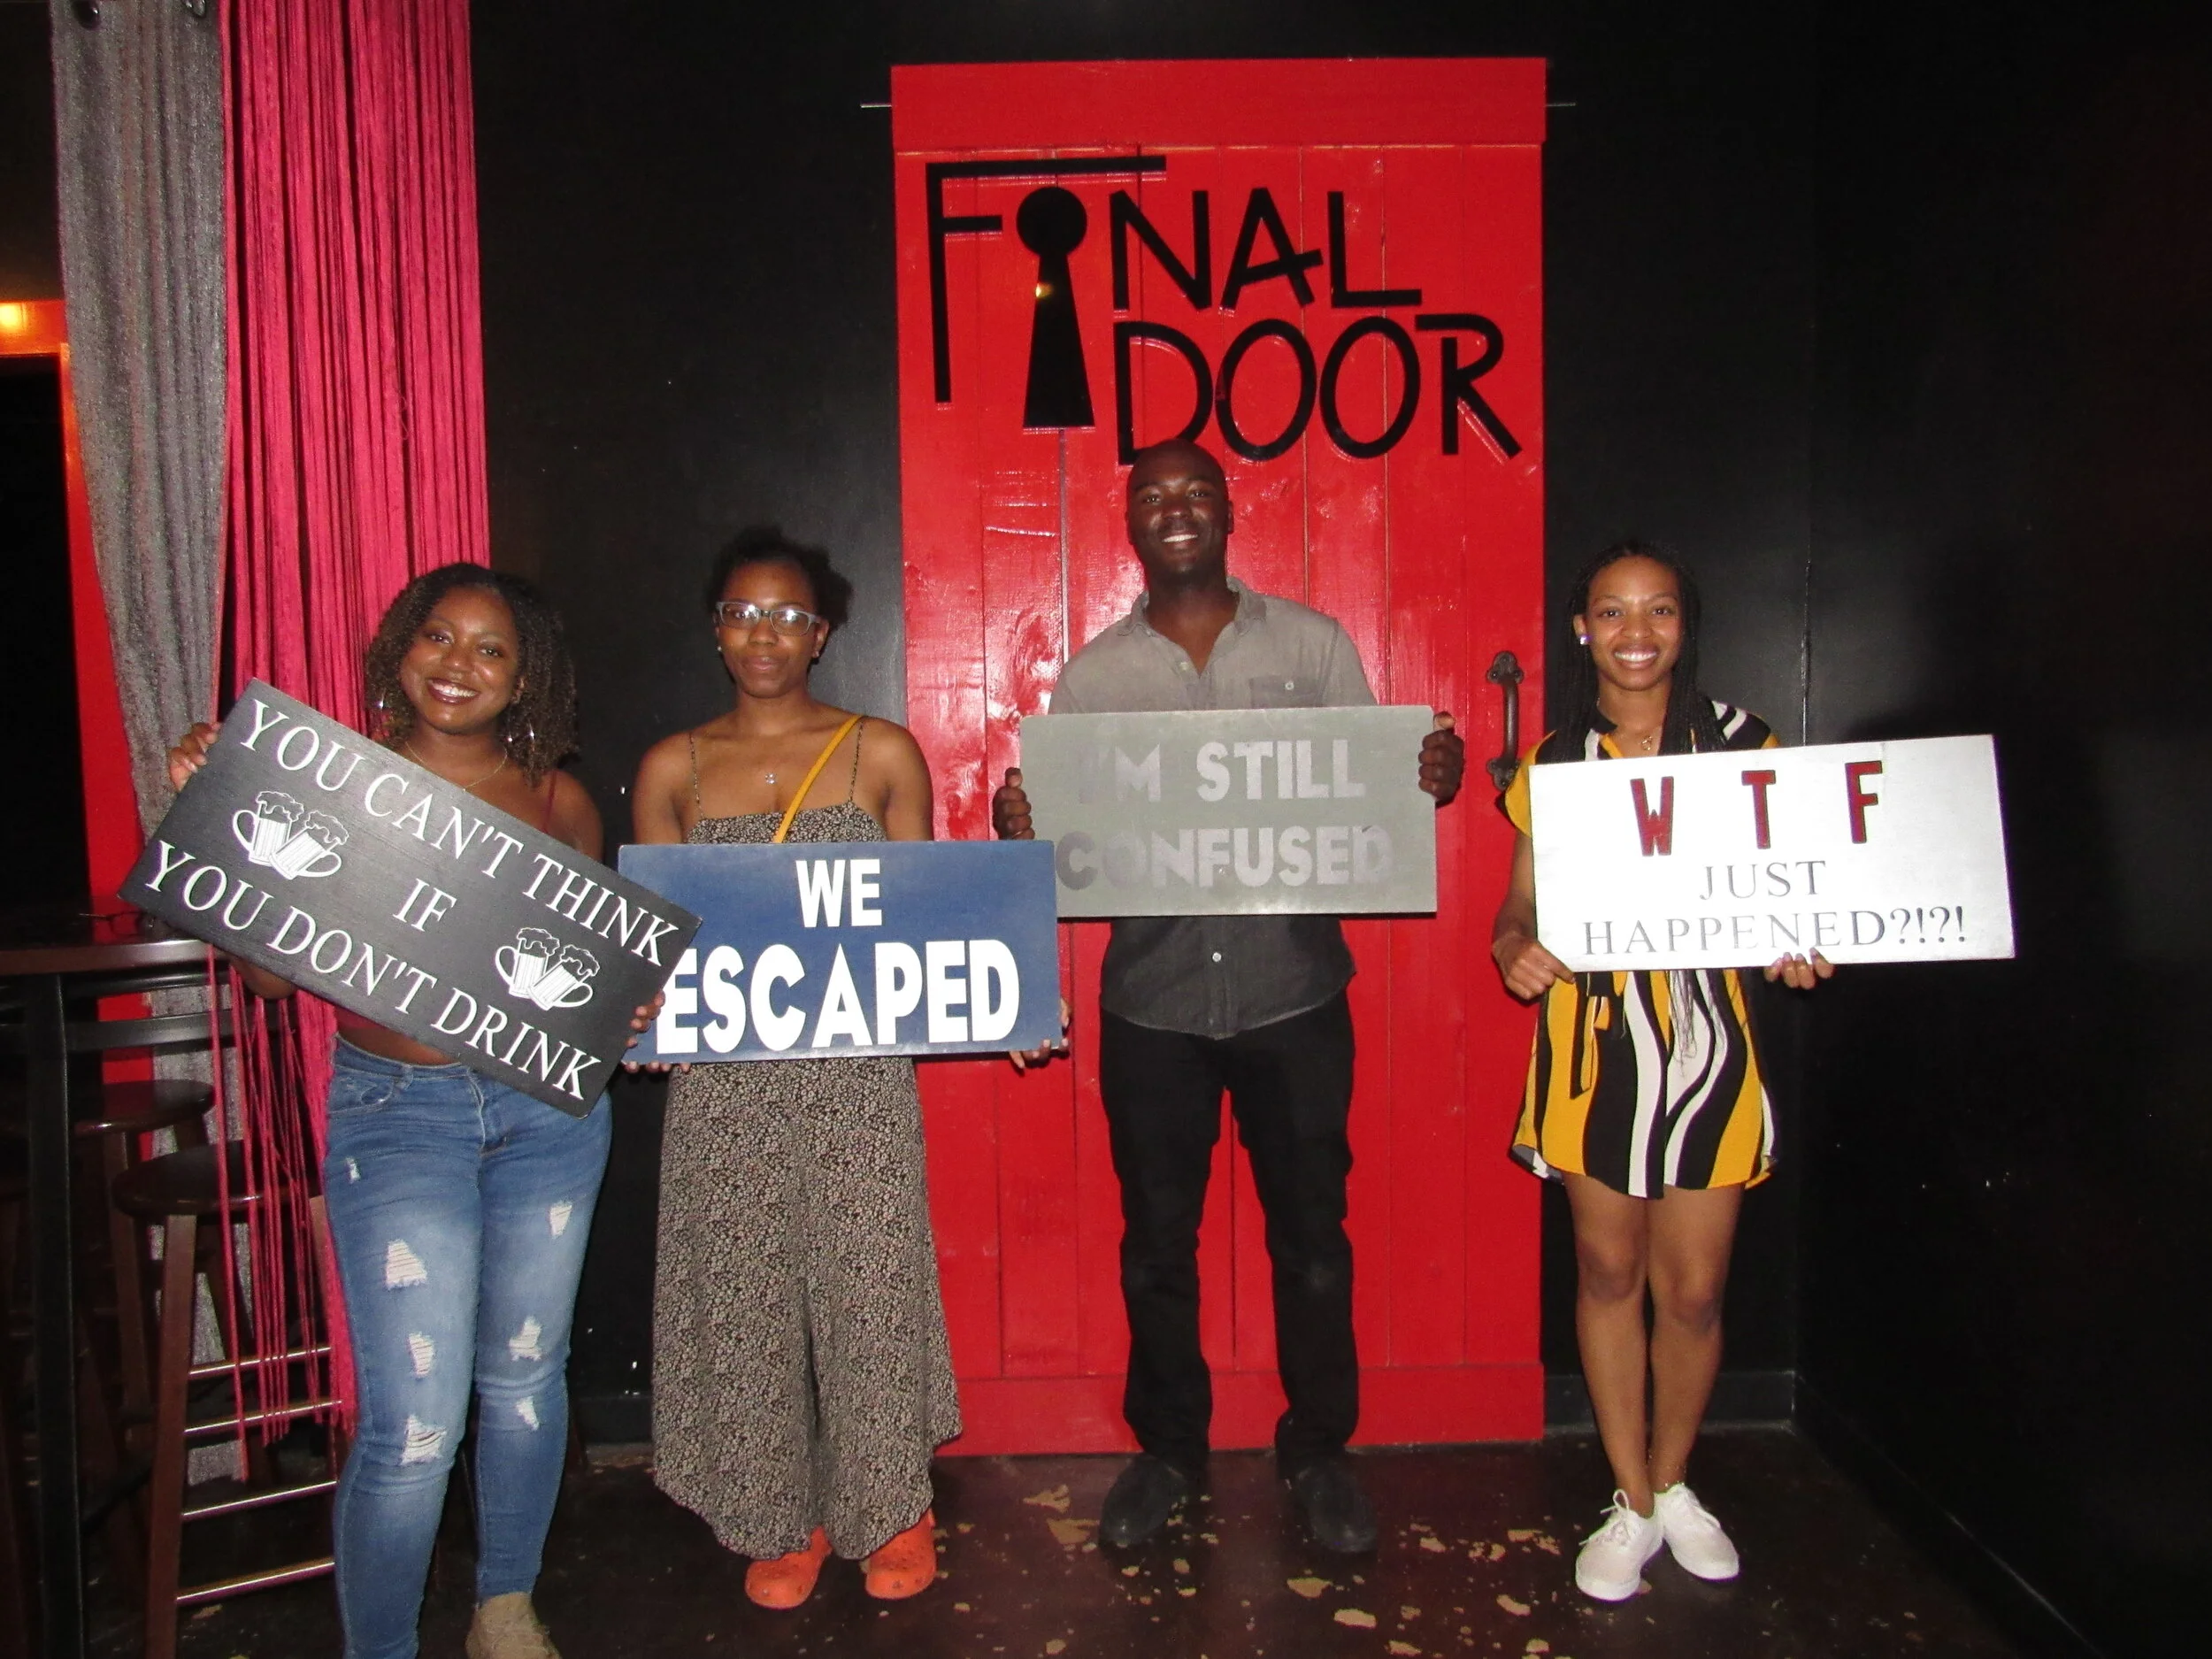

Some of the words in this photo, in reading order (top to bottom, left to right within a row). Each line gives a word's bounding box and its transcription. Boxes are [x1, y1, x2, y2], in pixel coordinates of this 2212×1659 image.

[926, 156, 1422, 428] FINAL
[1114, 313, 1522, 465] DOOR
[1196, 739, 1366, 801] STILL
[240, 699, 363, 791] YOU
[365, 772, 524, 879] CAN'T
[523, 853, 679, 966] THINK
[1056, 825, 1395, 890] CONFUSED
[393, 879, 457, 932] IF
[796, 859, 882, 927] WE
[1700, 860, 1826, 901] JUST
[1583, 906, 1966, 956] HAPPENED?!?!
[145, 841, 274, 930] YOU
[266, 906, 437, 1015] DON'T
[431, 987, 602, 1100] DRINK
[657, 939, 1019, 1054] ESCAPED
